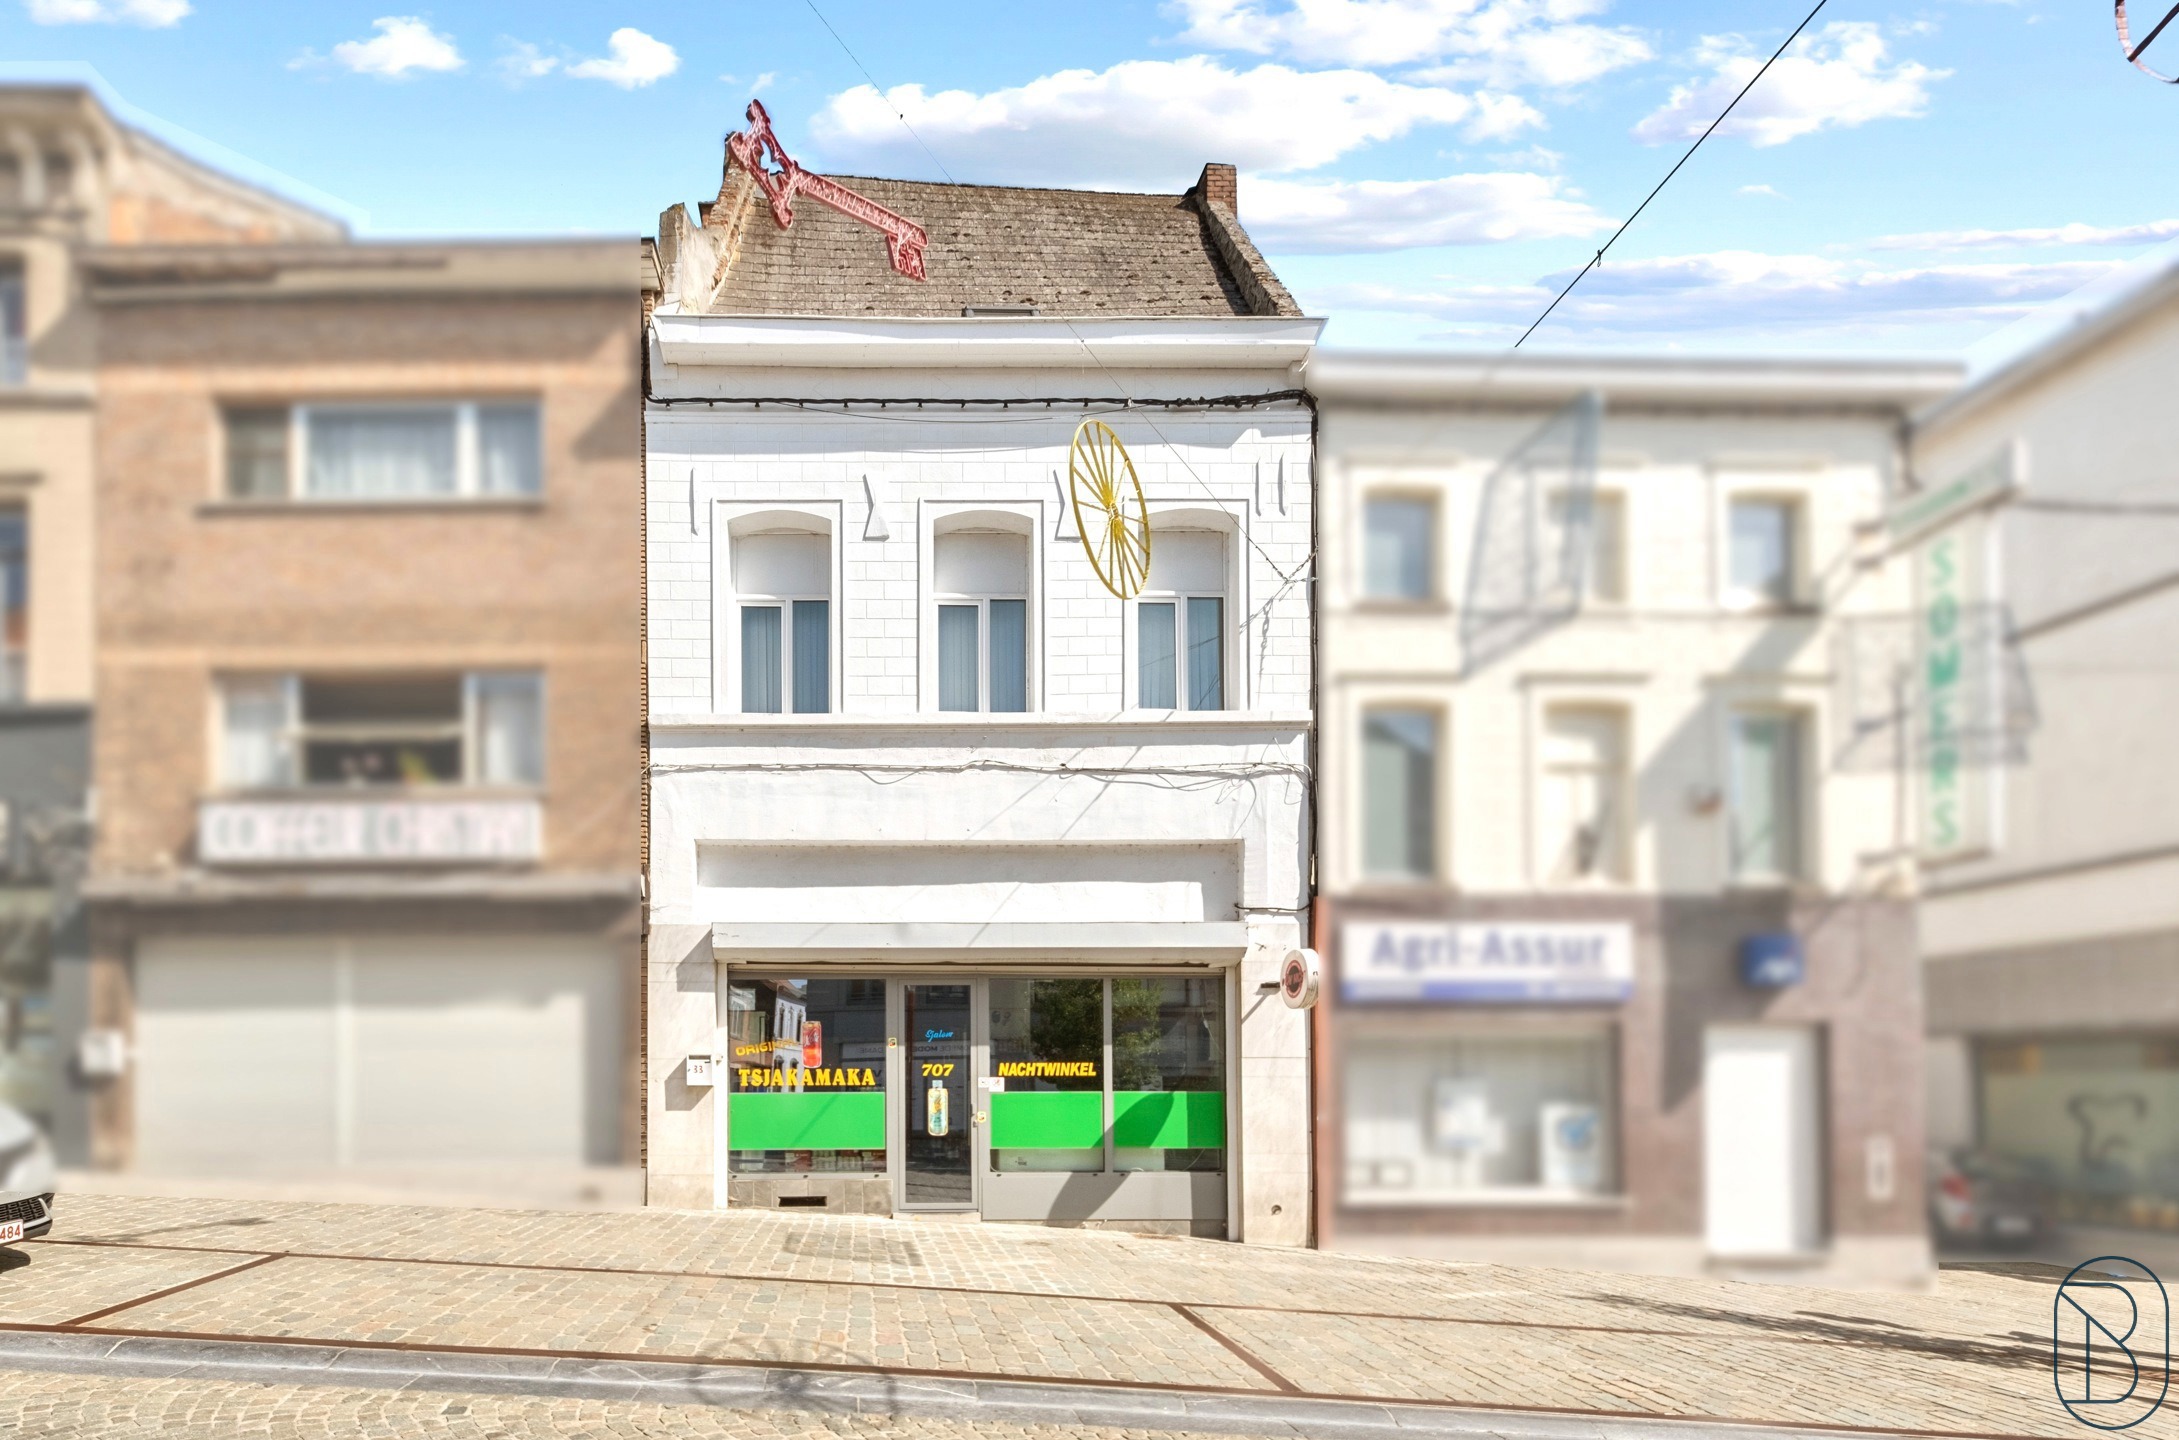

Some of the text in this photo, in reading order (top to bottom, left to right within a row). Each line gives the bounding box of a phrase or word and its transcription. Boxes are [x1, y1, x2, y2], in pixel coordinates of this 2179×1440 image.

[1369, 930, 1604, 971] Agri-Assur
[738, 1067, 876, 1087] TSJAKAMAKA
[922, 1063, 955, 1077] 707
[998, 1062, 1097, 1077] NACHTWINKEL
[0, 1224, 21, 1241] 484
